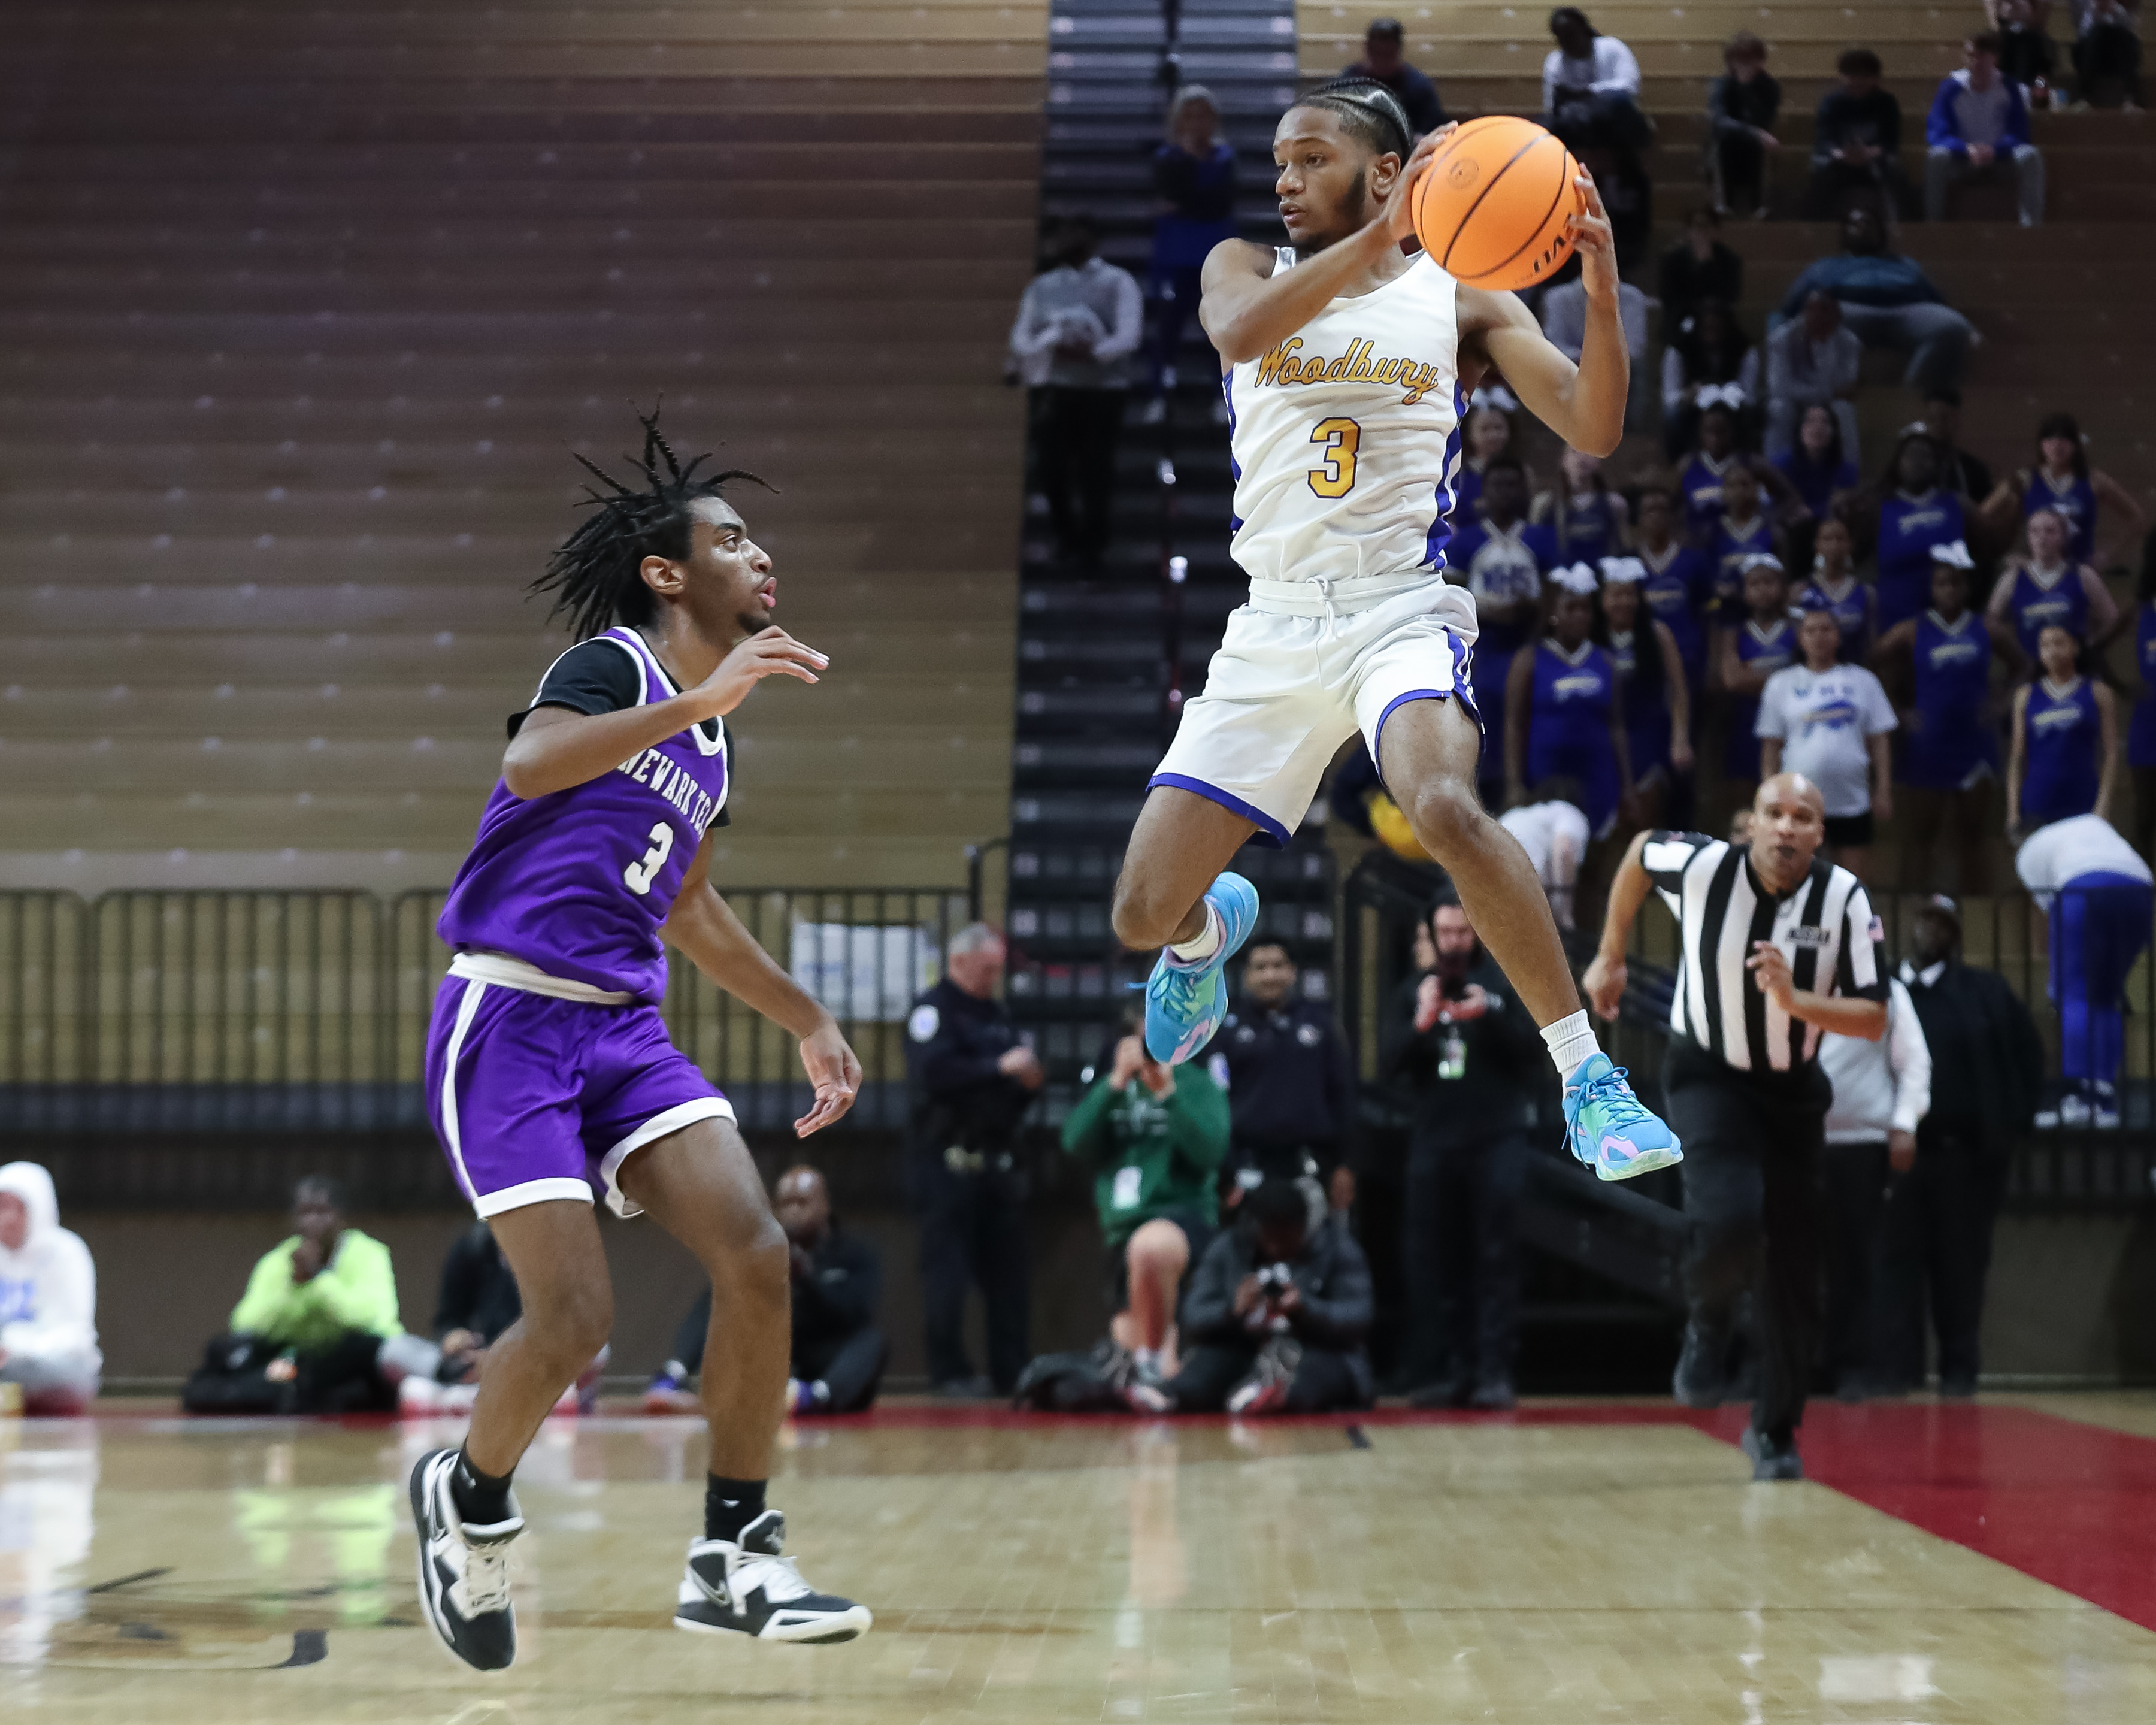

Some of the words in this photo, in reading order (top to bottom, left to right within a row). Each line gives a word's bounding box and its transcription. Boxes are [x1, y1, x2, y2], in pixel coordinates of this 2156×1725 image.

[1255, 337, 1439, 405] Woodbury
[1307, 416, 1361, 500] 3
[617, 748, 699, 816] NEWARK
[689, 789, 711, 842] TEC
[623, 821, 674, 896] 3
